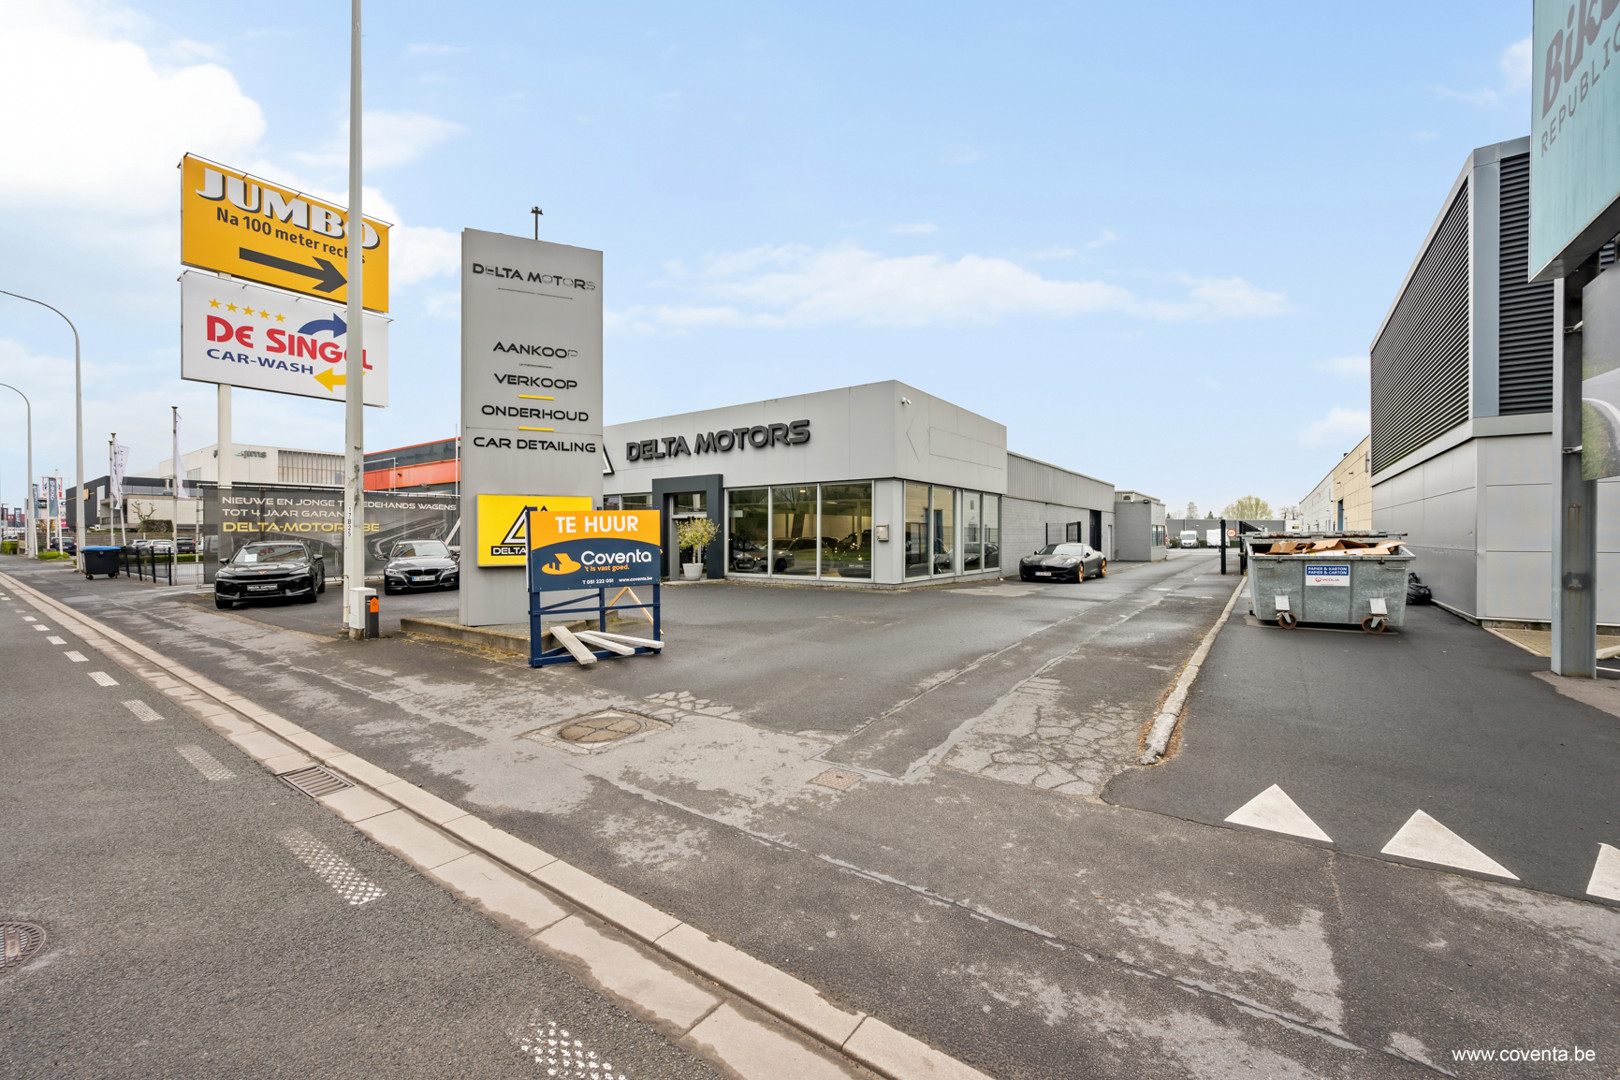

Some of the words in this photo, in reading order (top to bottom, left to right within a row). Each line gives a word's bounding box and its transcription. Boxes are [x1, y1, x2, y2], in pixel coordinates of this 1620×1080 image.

[195, 167, 380, 250] JUMBO
[217, 206, 239, 226] Na
[243, 216, 271, 236] 100
[275, 227, 320, 250] meter
[472, 263, 524, 281] DELTA
[527, 272, 596, 291] MOTORS
[206, 314, 254, 349] DE
[266, 328, 373, 370] SINGL
[493, 341, 578, 359] AANKOOP
[206, 348, 314, 375] CAR-WASH
[494, 373, 578, 390] VERKOOP
[481, 404, 589, 422] ONDERHOUD
[473, 437, 512, 449] CAR
[516, 438, 597, 453] DETAILING
[626, 436, 691, 460] DELTA
[694, 419, 810, 454] MOTORS
[222, 496, 274, 505] NIEUWE
[276, 498, 293, 506] EN
[296, 499, 335, 507] JONGE
[418, 503, 457, 511] WAGENS
[222, 508, 248, 517] TOT
[251, 509, 260, 517] 4
[263, 509, 299, 517] JAAR
[555, 516, 576, 533] TE
[585, 515, 639, 533] HUUR
[492, 547, 527, 555] DELTA
[581, 549, 652, 566] Coventa
[612, 564, 630, 573] goed.
